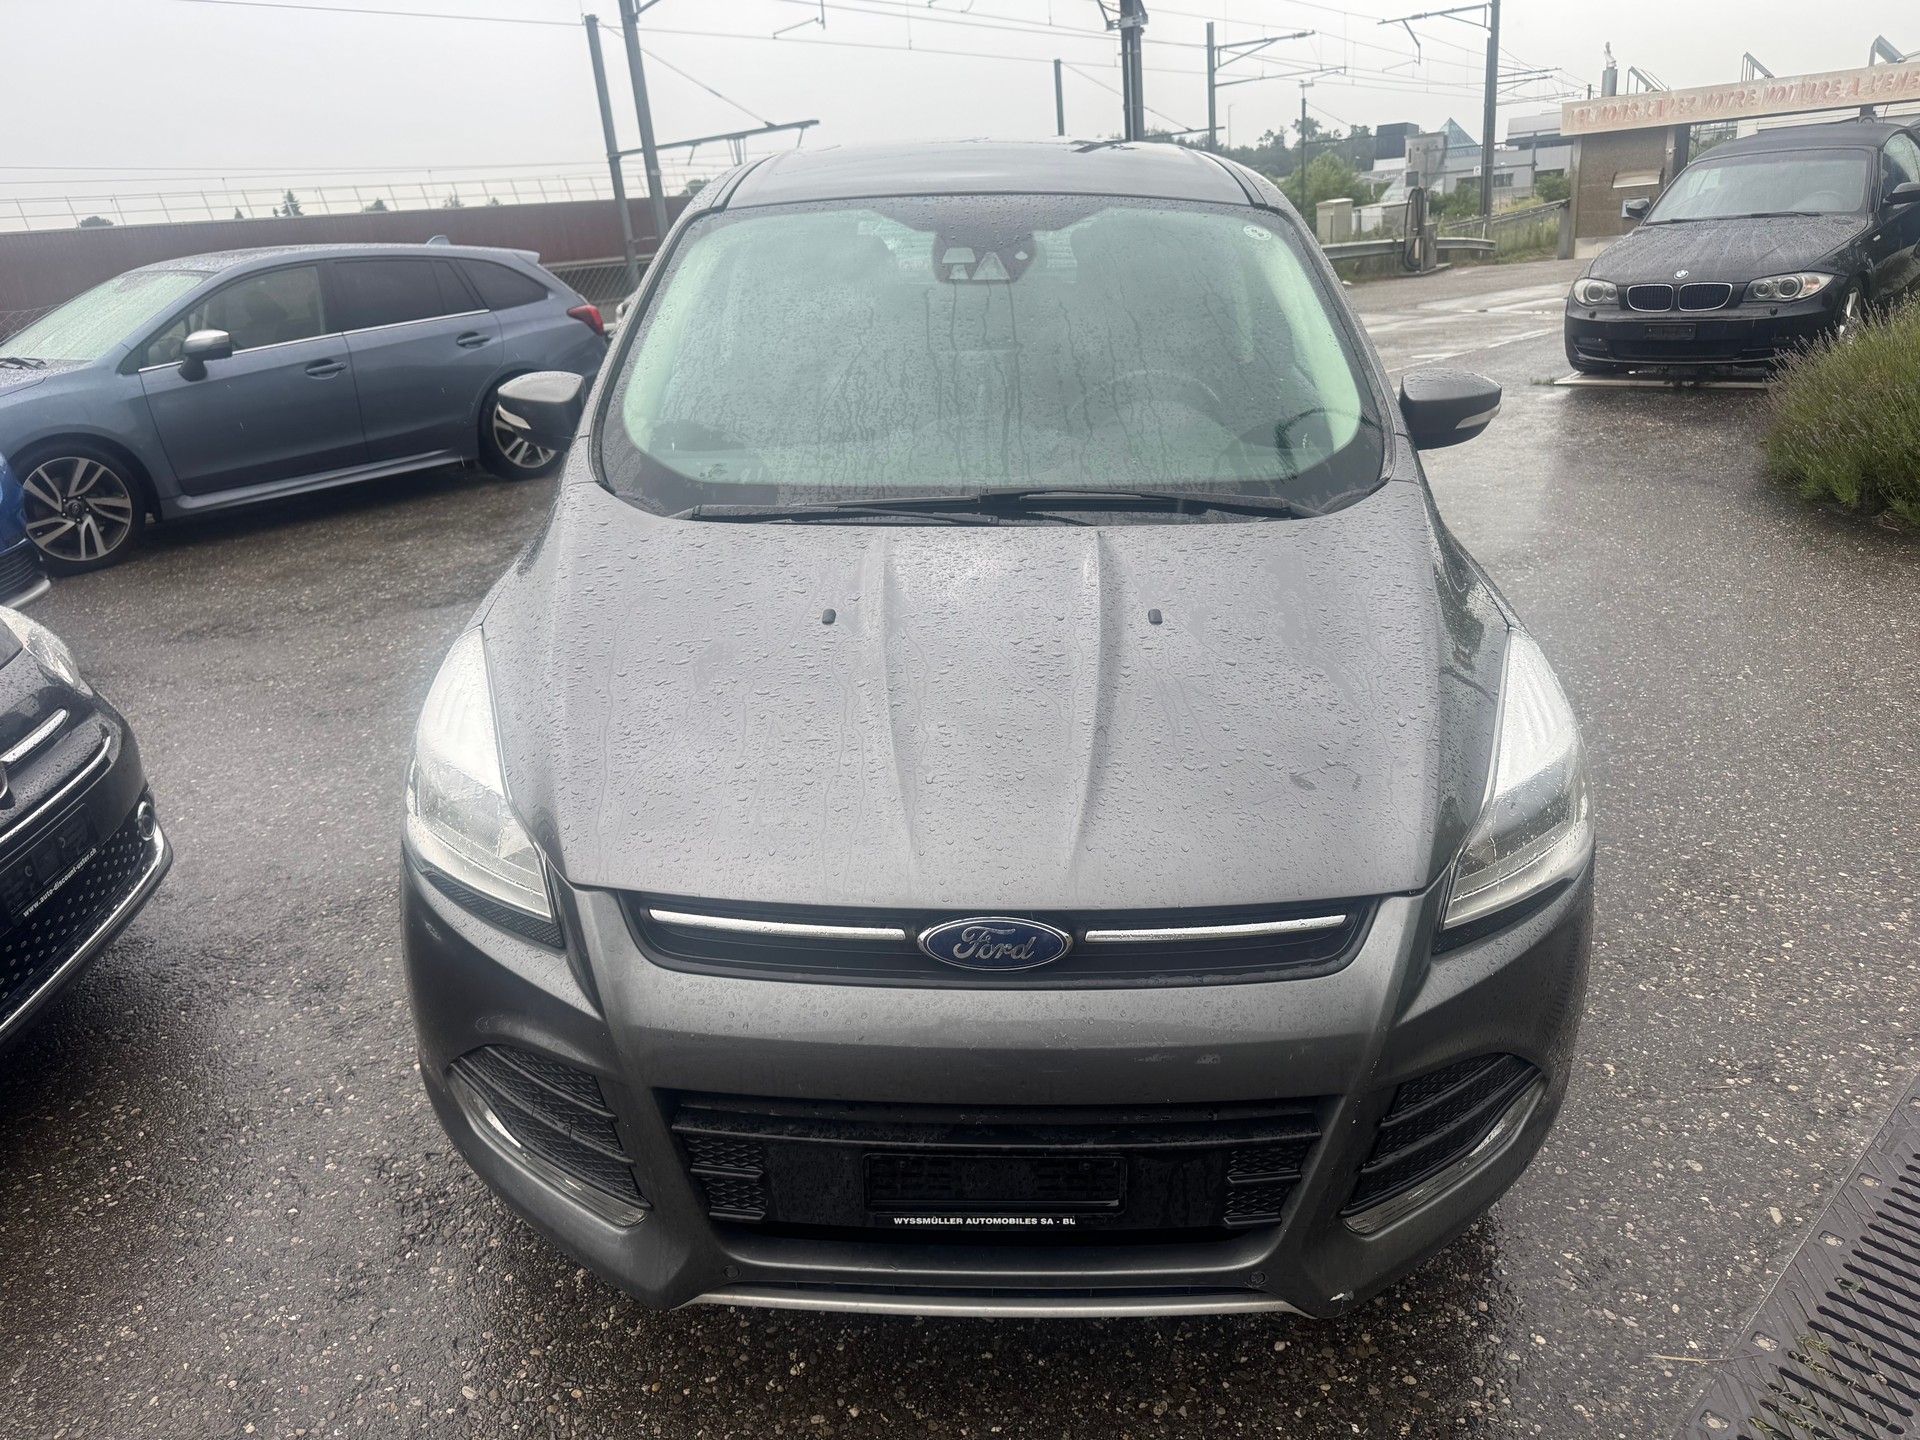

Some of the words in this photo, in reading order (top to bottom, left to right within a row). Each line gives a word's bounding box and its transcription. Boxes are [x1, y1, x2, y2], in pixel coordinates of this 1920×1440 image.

[1643, 96, 1697, 118] LAVEZ
[1700, 89, 1758, 112] VOTRE
[1762, 78, 1842, 104] VOITURE
[22, 847, 98, 918] www.auto-discount-uster.ch
[952, 925, 1037, 960] Ford
[893, 1216, 964, 1225] WYSSMÜLLER
[965, 1216, 1038, 1225] AUTOMOBILES
[1040, 1217, 1054, 1225] SA
